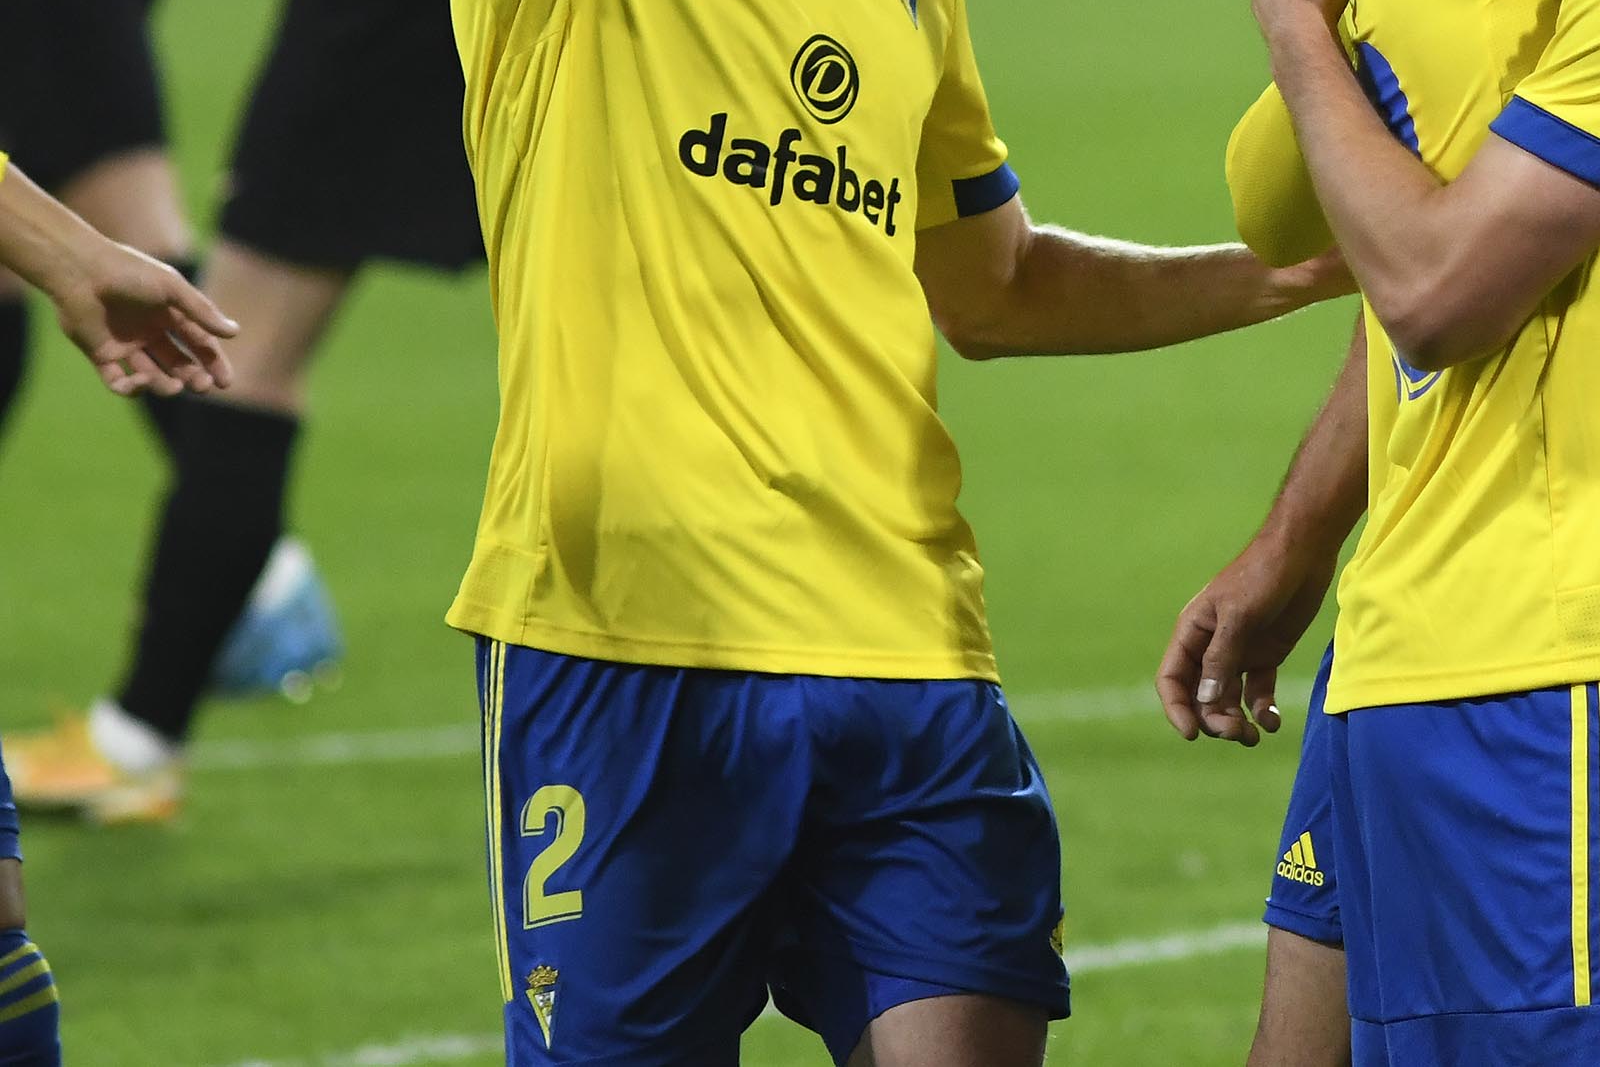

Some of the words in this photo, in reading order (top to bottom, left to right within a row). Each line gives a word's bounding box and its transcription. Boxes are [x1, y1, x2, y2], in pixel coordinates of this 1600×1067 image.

[679, 112, 901, 237] dafabet
[519, 784, 586, 930] 2
[1277, 861, 1324, 887] adidas
